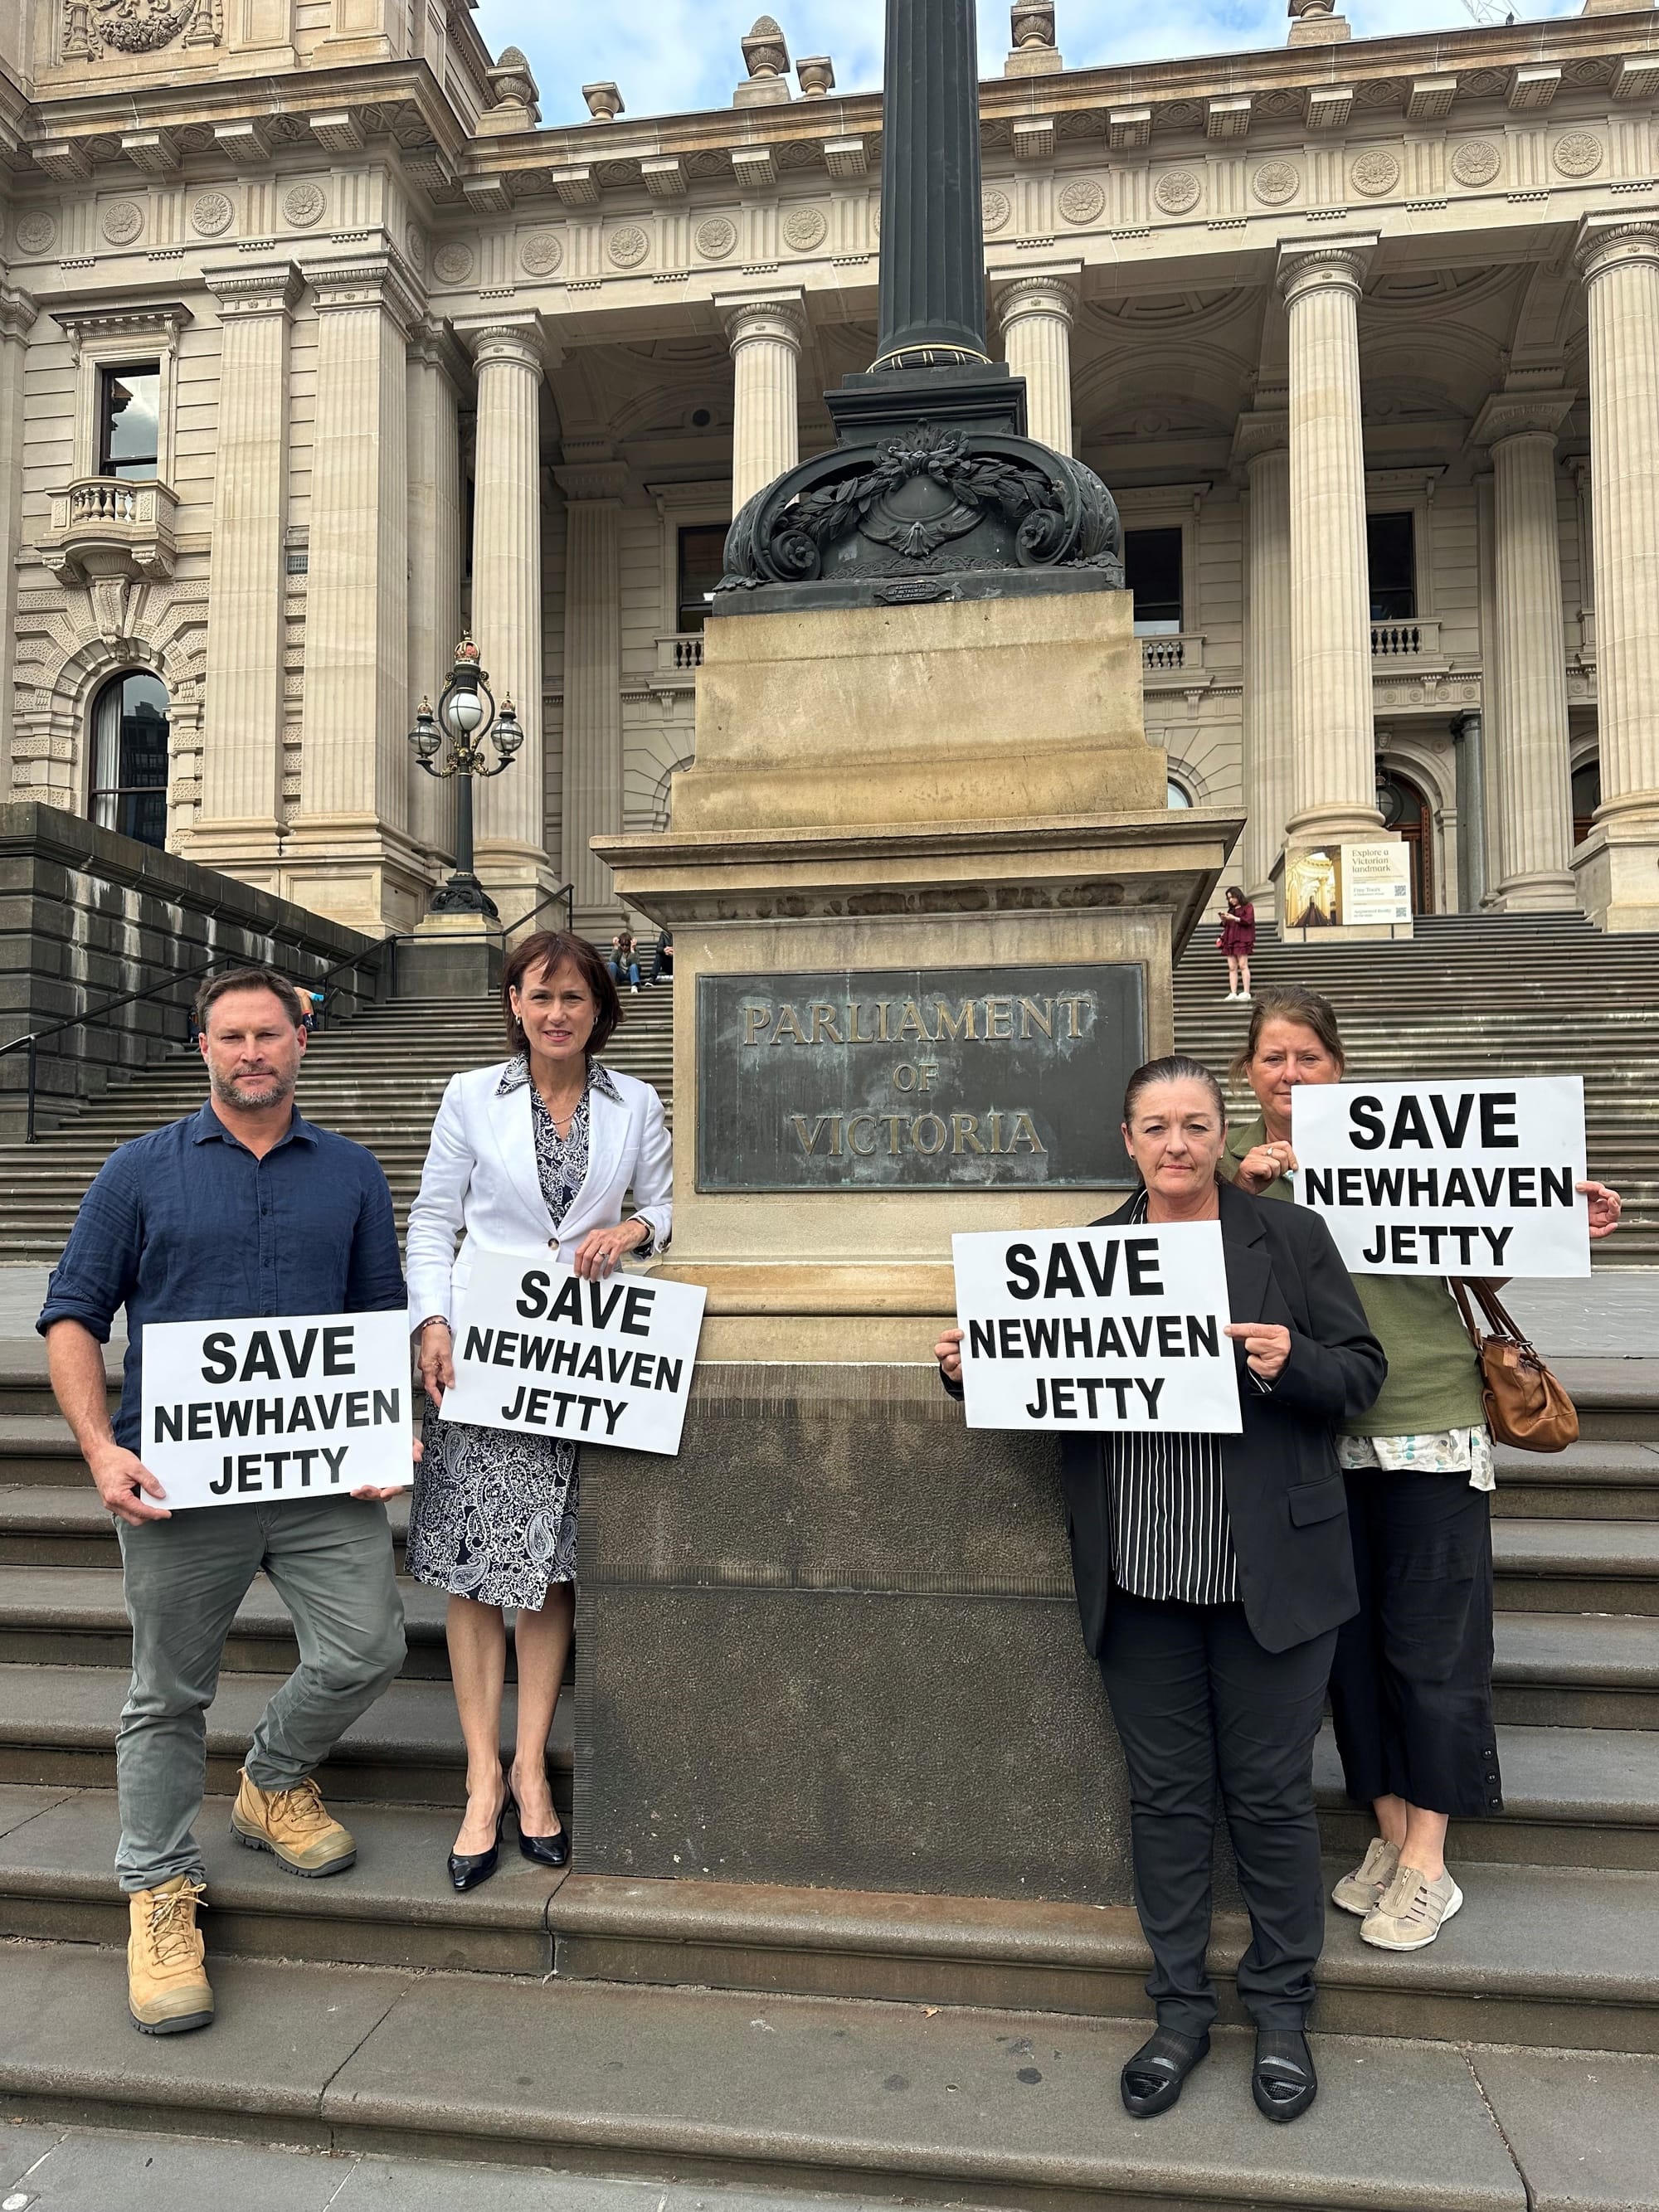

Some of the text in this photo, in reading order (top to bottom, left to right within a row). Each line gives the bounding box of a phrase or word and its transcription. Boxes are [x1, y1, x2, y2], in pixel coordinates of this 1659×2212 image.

[1352, 848, 1382, 858] Explore
[1352, 856, 1389, 865] Victorian
[1352, 864, 1391, 873] landmark
[742, 996, 1092, 1046] PARLIAMENT
[893, 1063, 940, 1092] OF
[791, 1112, 1048, 1156] VICTORIA
[1348, 1092, 1519, 1150] SAVE
[1305, 1166, 1574, 1208] NEWHAVEN
[1005, 1237, 1165, 1300] SAVE
[1362, 1225, 1514, 1266] JETTY
[516, 1270, 656, 1337] SAVE
[201, 1325, 356, 1384] SAVE
[463, 1325, 684, 1393] NEWHAVEN
[969, 1315, 1220, 1359] NEWHAVEN
[154, 1388, 400, 1443] NEWHAVEN
[501, 1385, 629, 1435] JETTY
[1025, 1378, 1165, 1419] JETTY
[209, 1446, 349, 1495] JETTY
